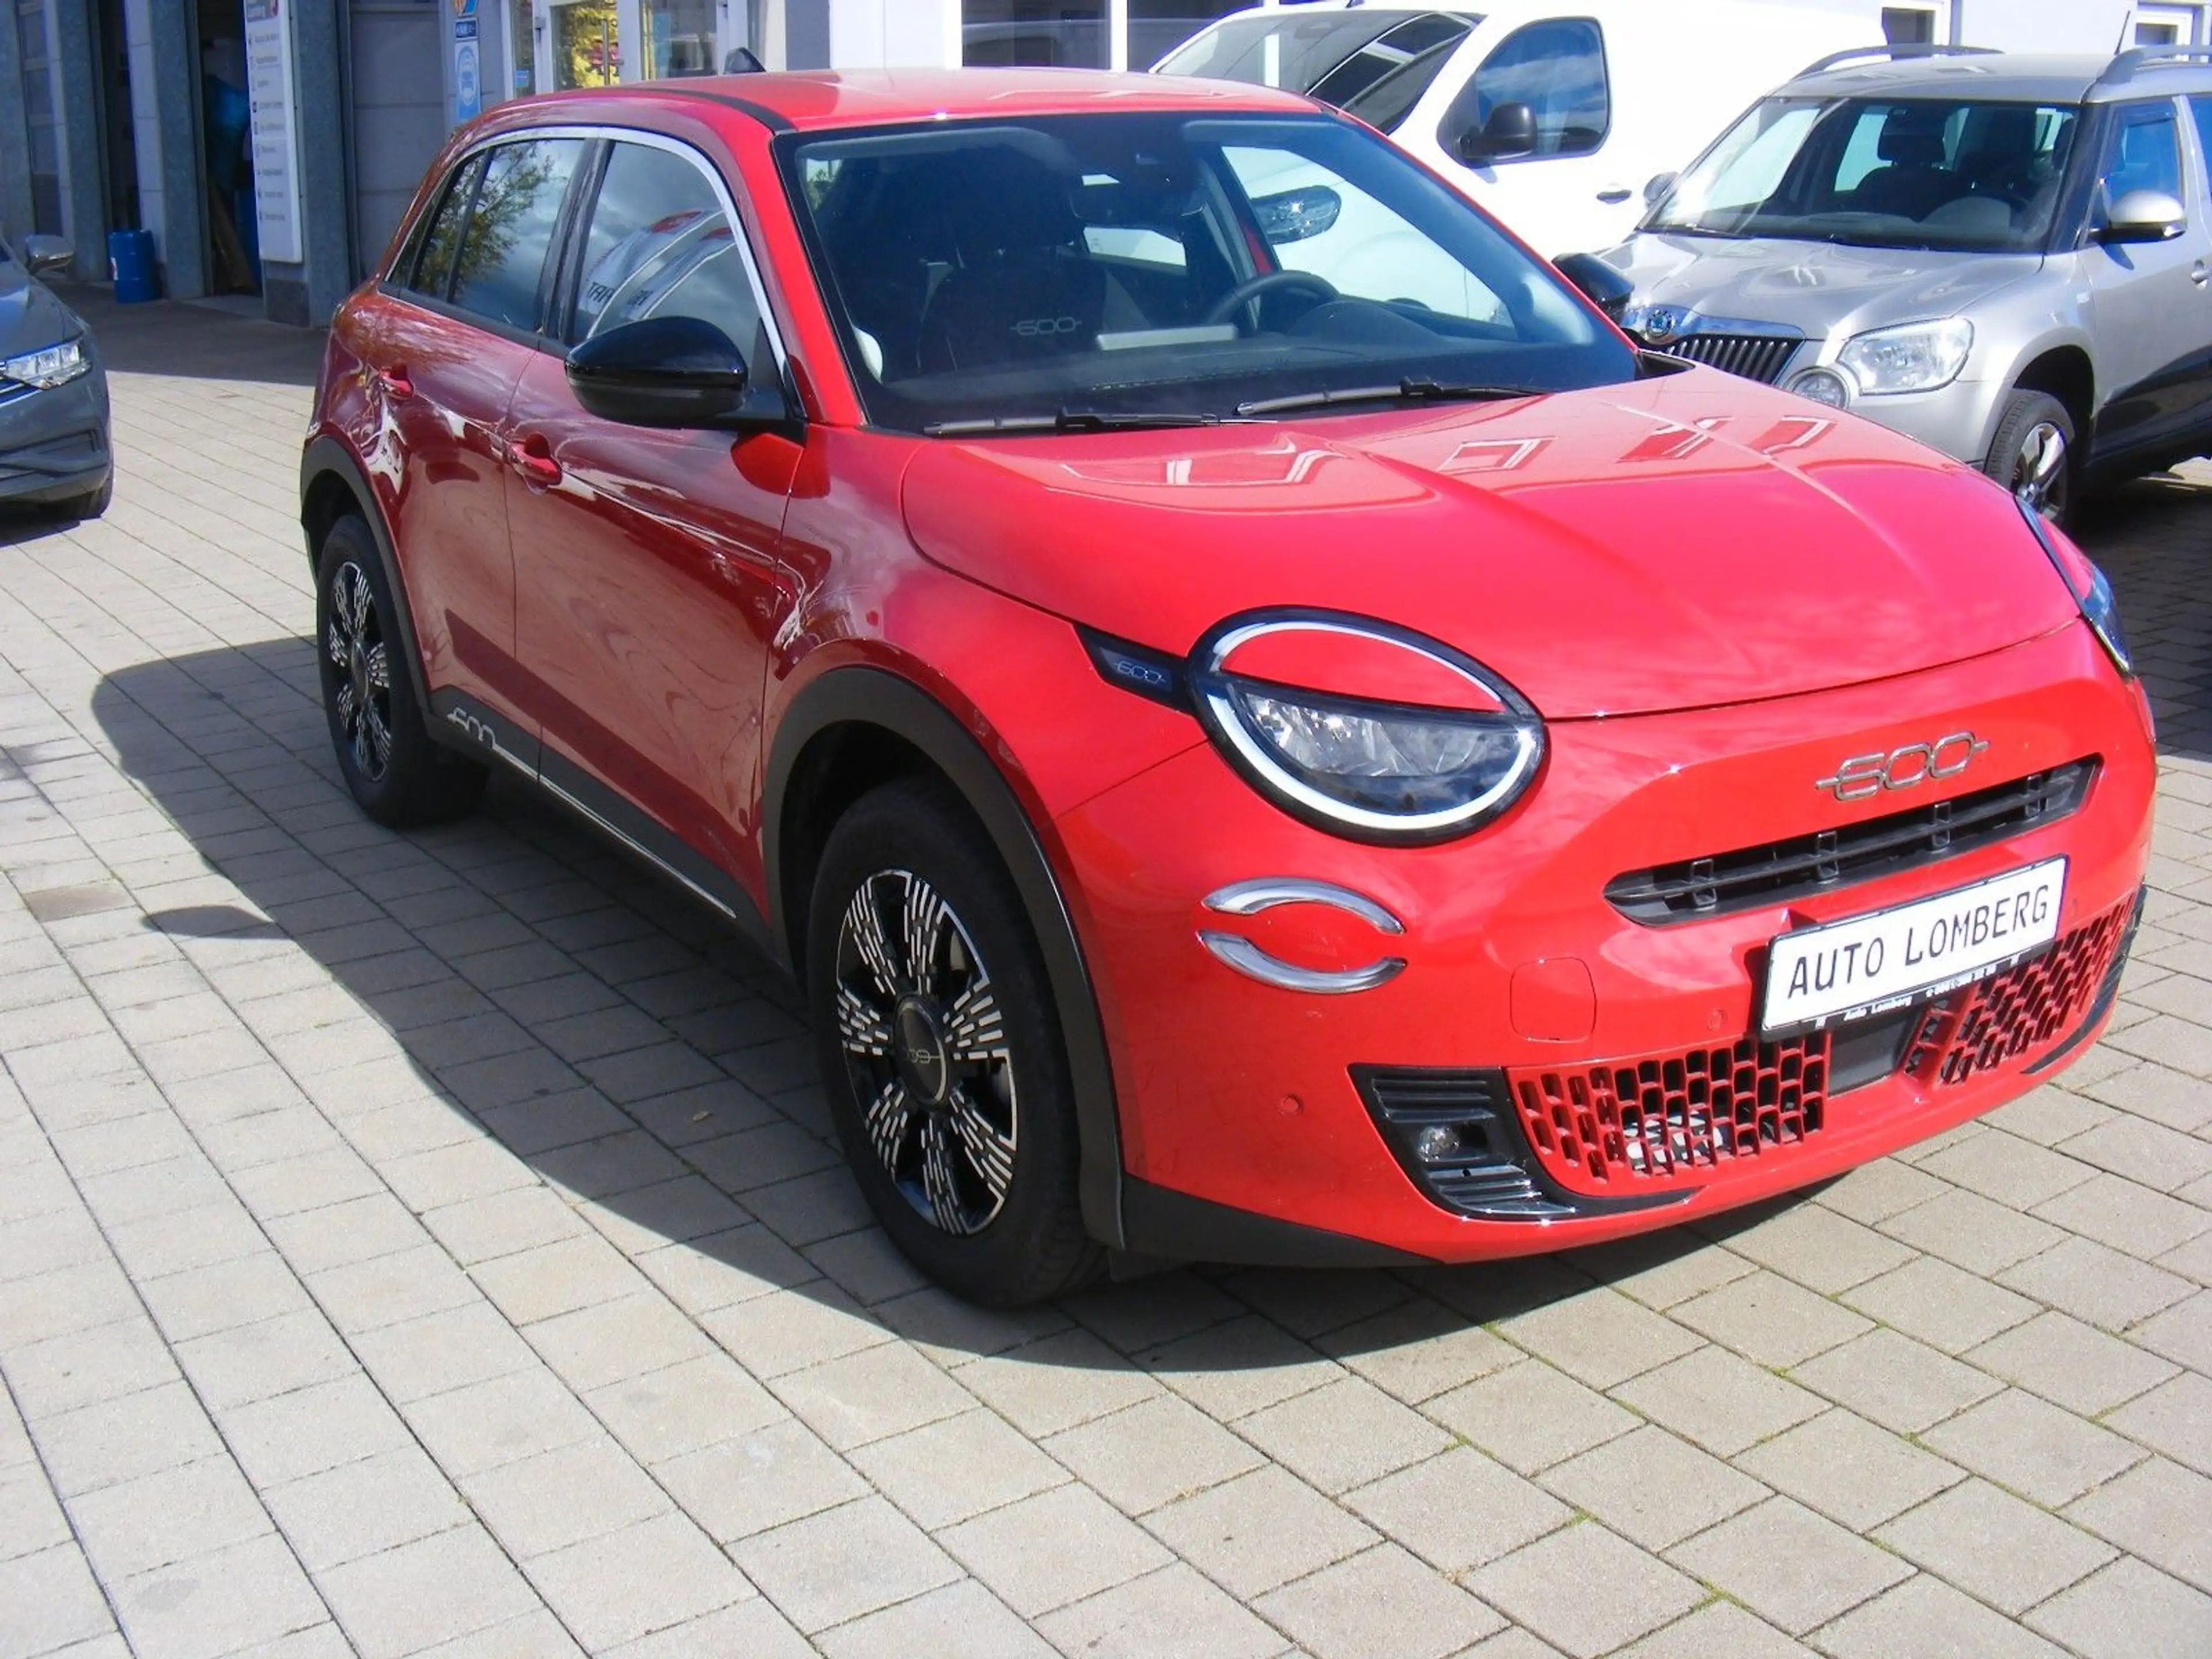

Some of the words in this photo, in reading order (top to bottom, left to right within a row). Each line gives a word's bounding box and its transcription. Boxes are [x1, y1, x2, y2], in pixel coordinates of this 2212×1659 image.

[1015, 316, 1076, 335] 600
[1115, 660, 1162, 684] 600
[1832, 730, 1977, 801] 600
[1787, 937, 1885, 999] AUTO
[1904, 884, 2050, 966] LOMBERG
